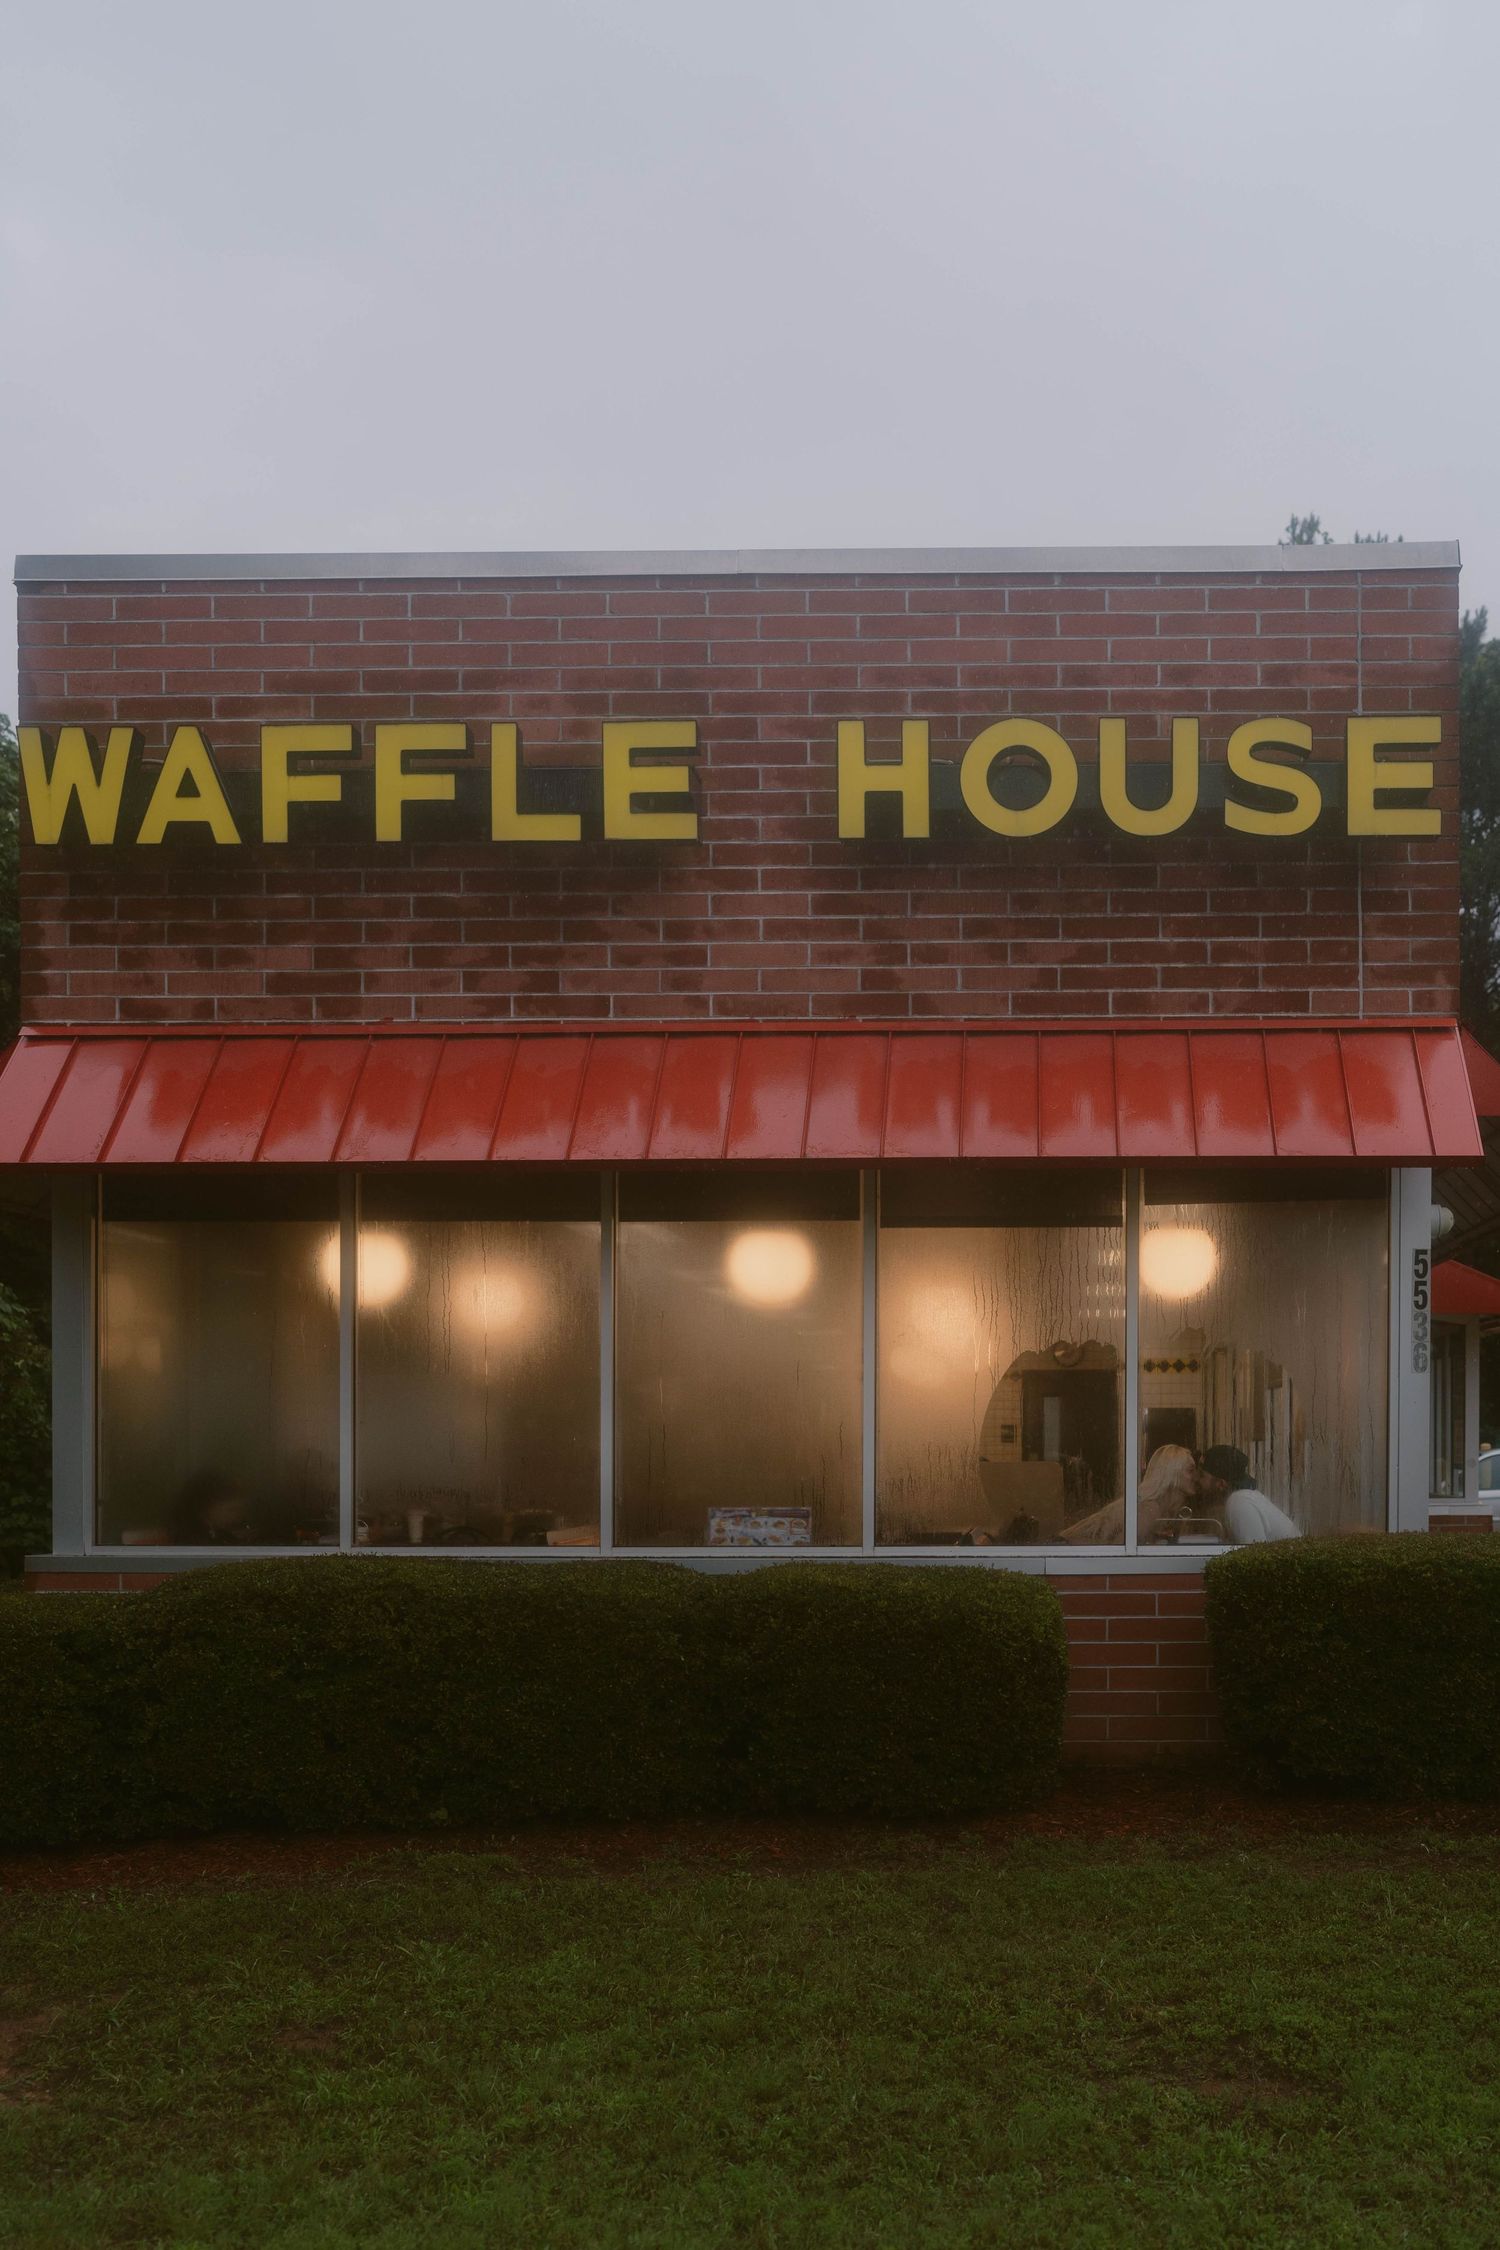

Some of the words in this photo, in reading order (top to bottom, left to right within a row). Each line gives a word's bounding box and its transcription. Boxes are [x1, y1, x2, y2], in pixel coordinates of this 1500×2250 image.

[17, 721, 698, 845] WAFFLE
[837, 716, 1442, 839] HOUSE
[1413, 1248, 1429, 1374] 5536
